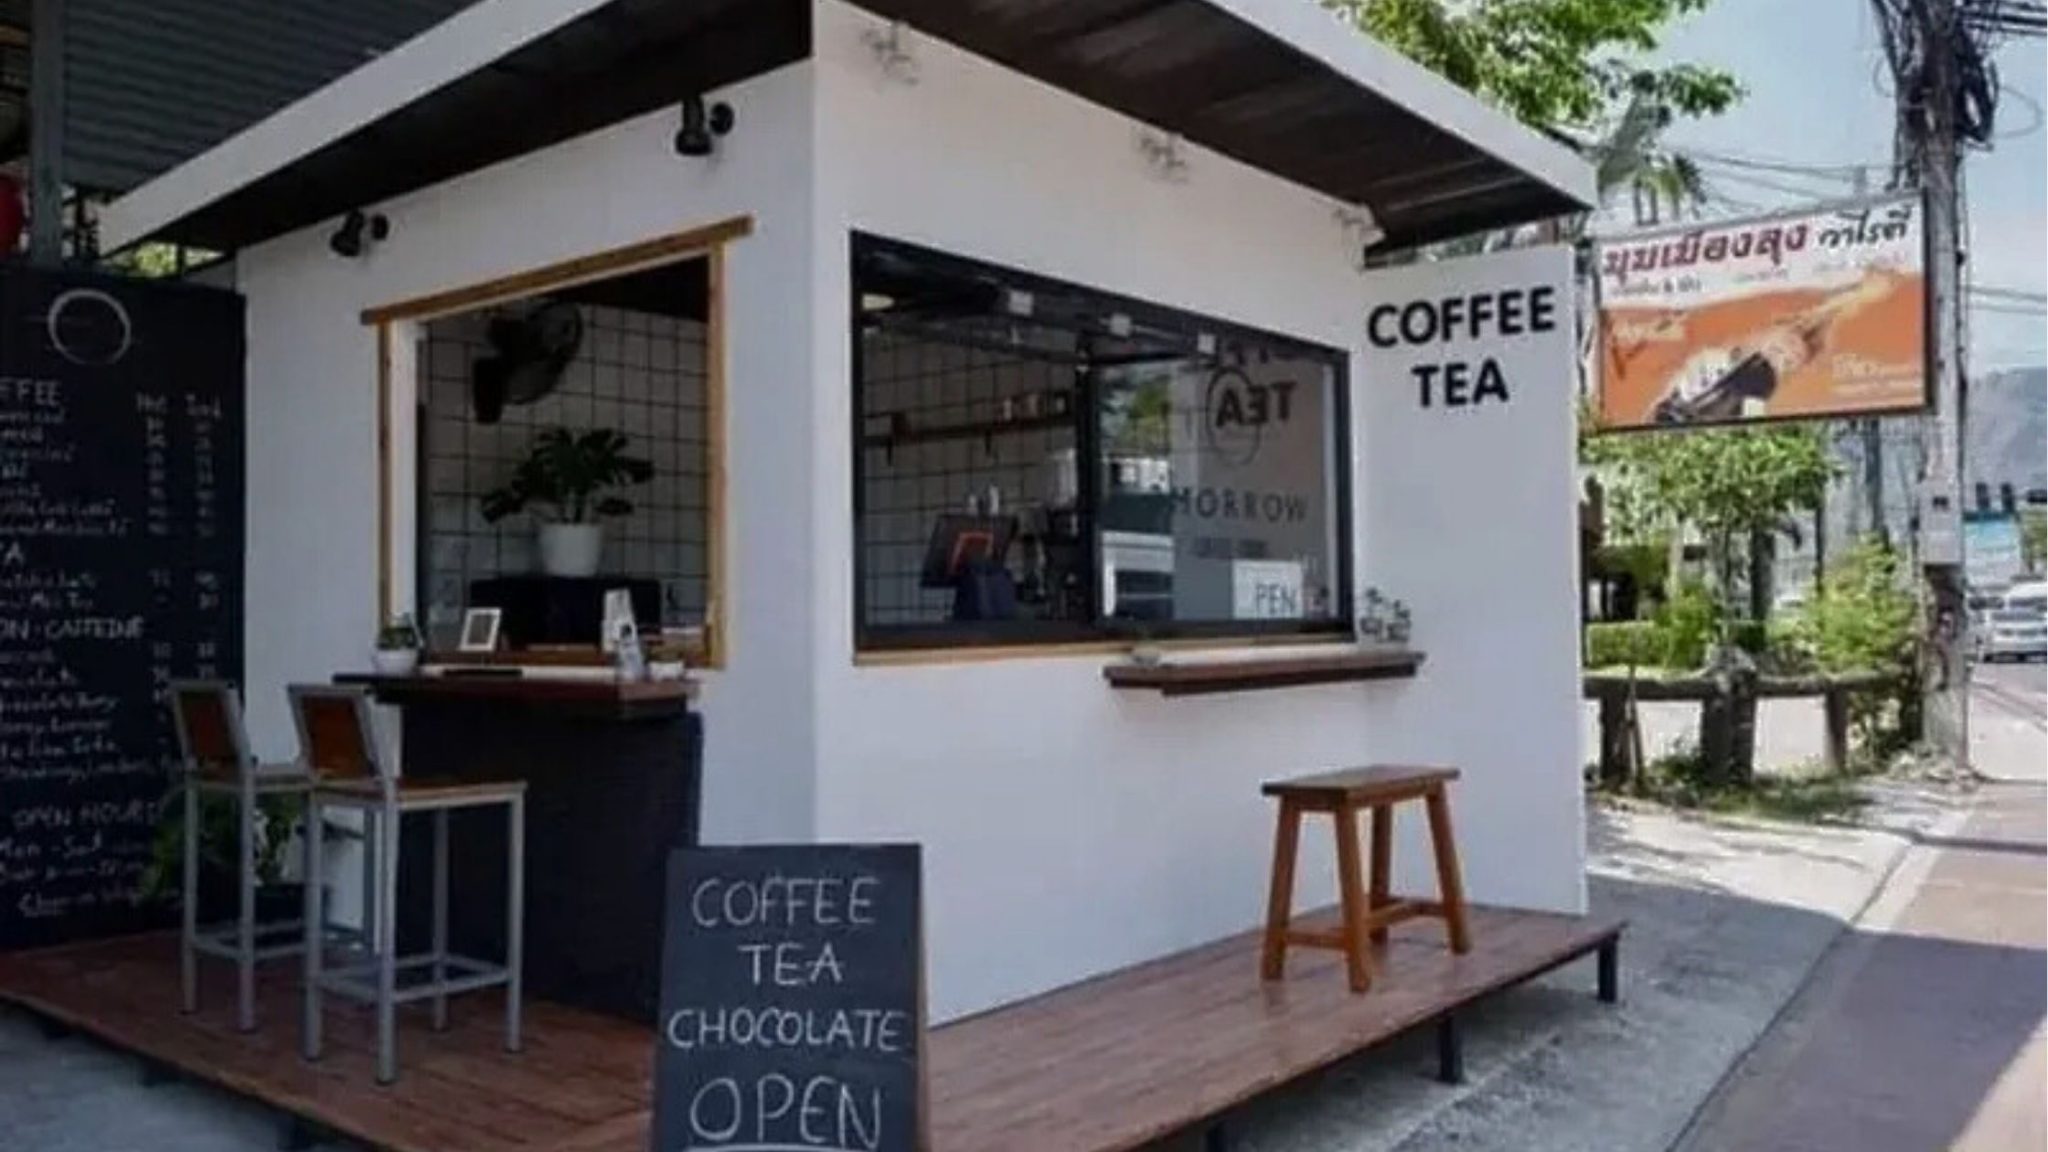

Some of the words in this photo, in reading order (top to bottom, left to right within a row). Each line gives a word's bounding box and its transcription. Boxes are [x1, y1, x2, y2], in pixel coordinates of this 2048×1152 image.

[1367, 286, 1556, 348] COFFEE
[1411, 357, 1510, 408] TEA
[693, 876, 881, 927] COFFEE
[737, 942, 843, 985] TEA
[667, 1006, 906, 1051] CHOCOLATE
[690, 1073, 882, 1150] OPEN
